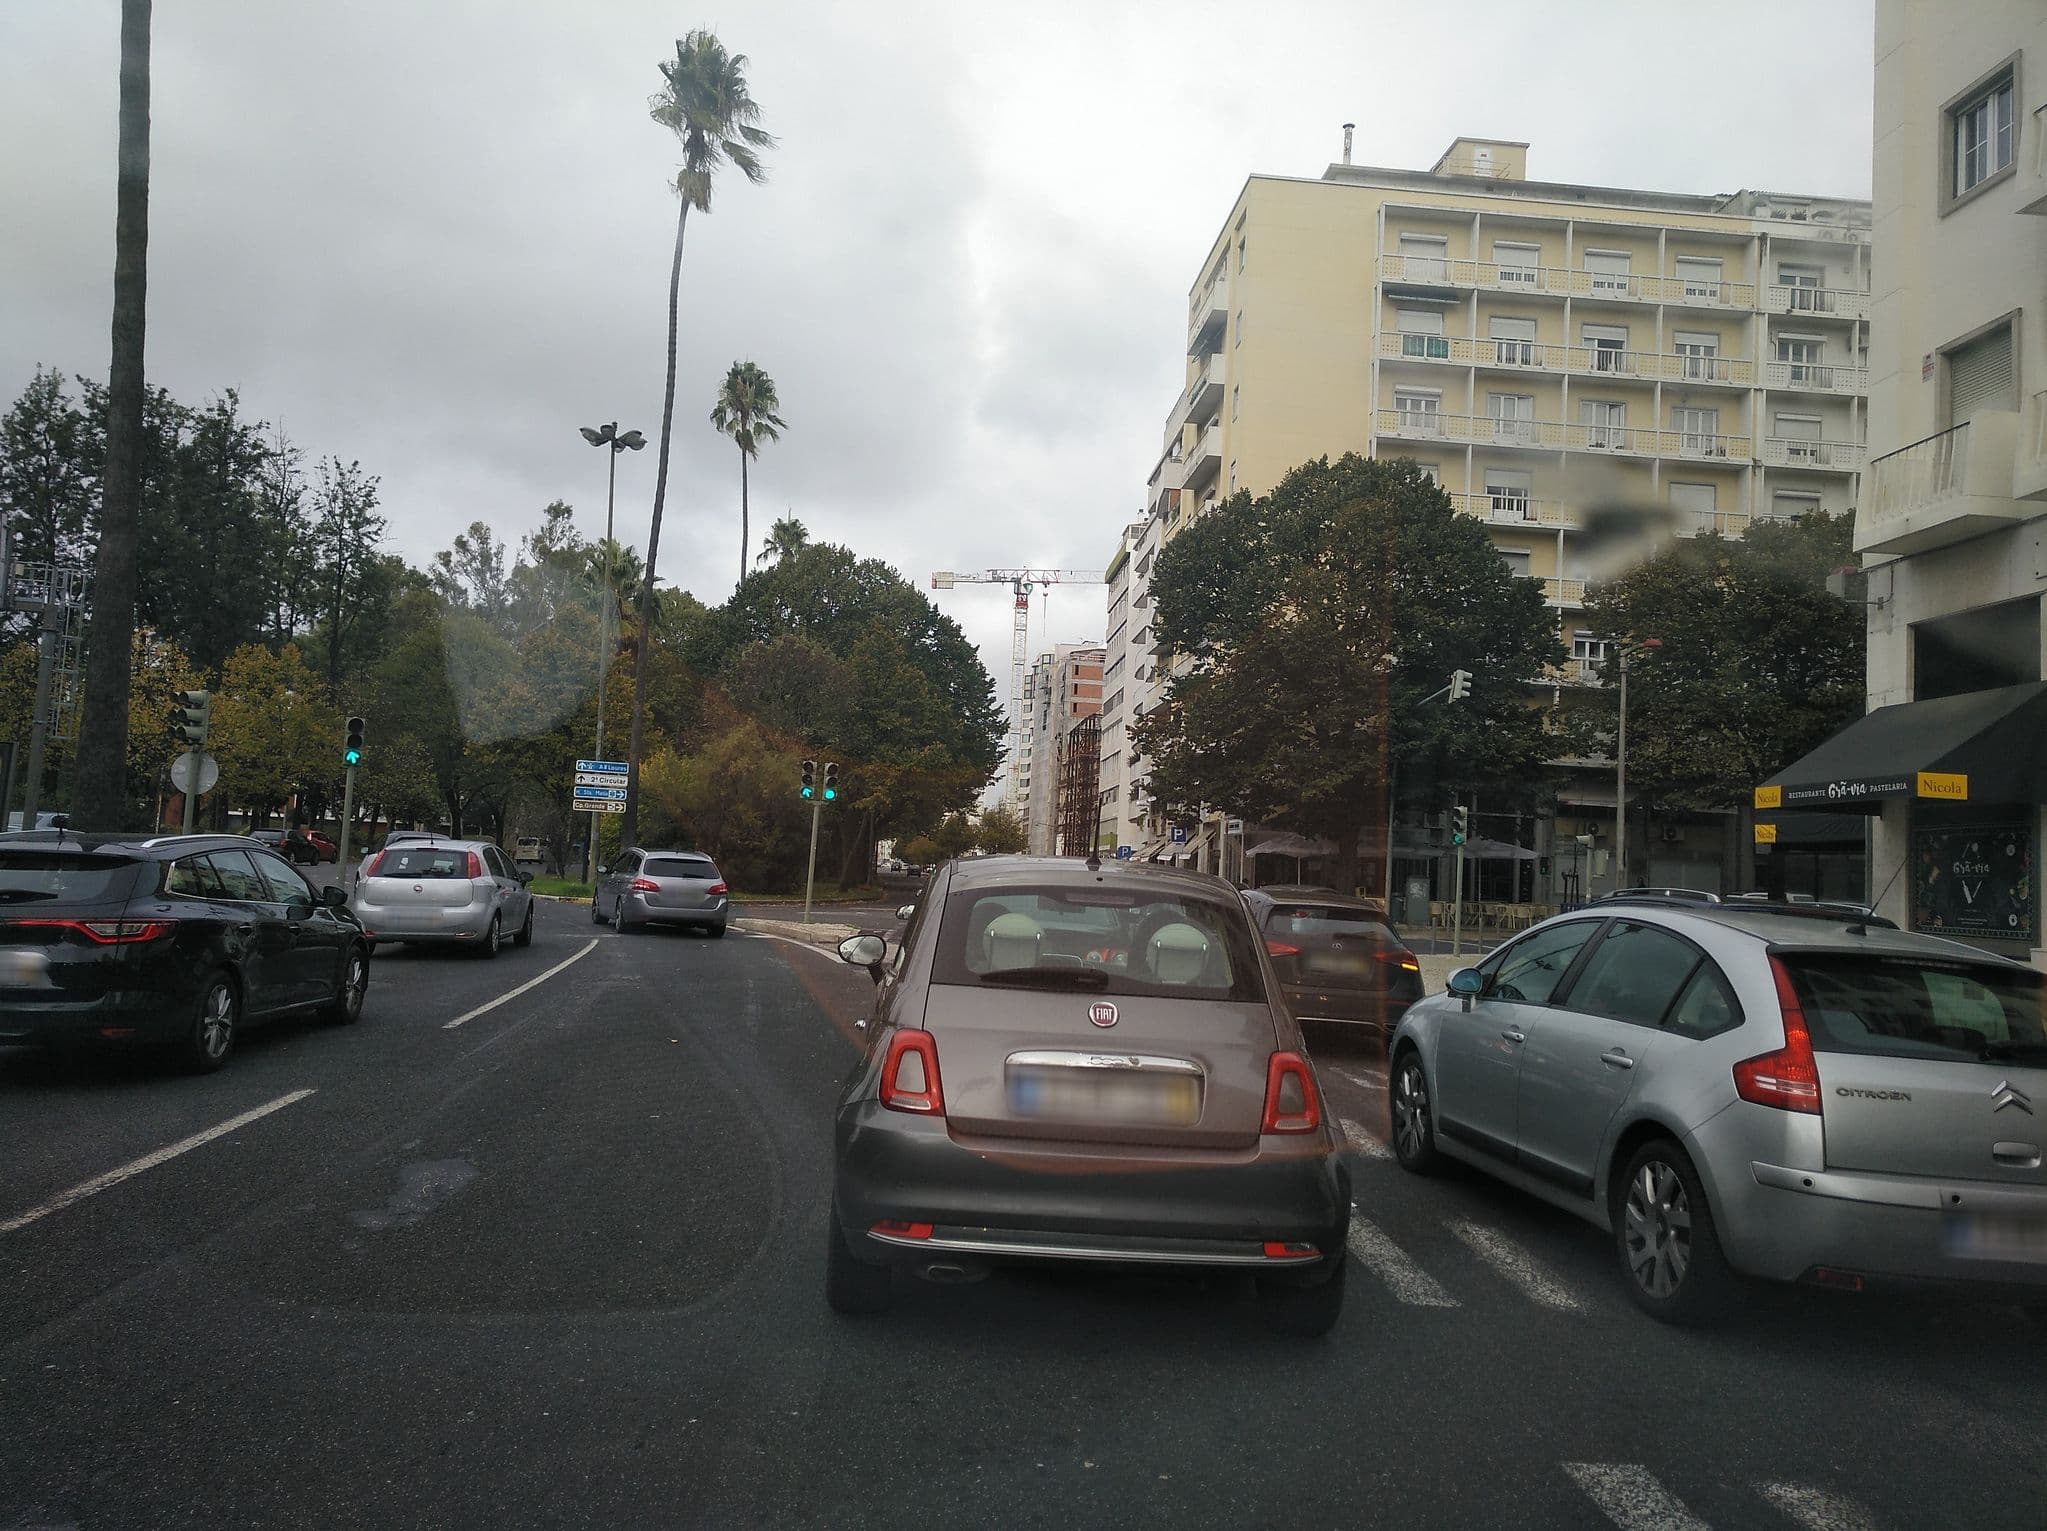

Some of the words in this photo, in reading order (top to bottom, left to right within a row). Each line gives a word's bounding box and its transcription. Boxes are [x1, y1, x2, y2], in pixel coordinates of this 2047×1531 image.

[599, 777, 626, 785] Circular
[1869, 782, 1908, 792] PASTELARIA
[1923, 780, 1962, 794] Nicola
[1174, 829, 1183, 840] P
[1121, 848, 1129, 857] P
[1096, 1007, 1113, 1021] FIAT
